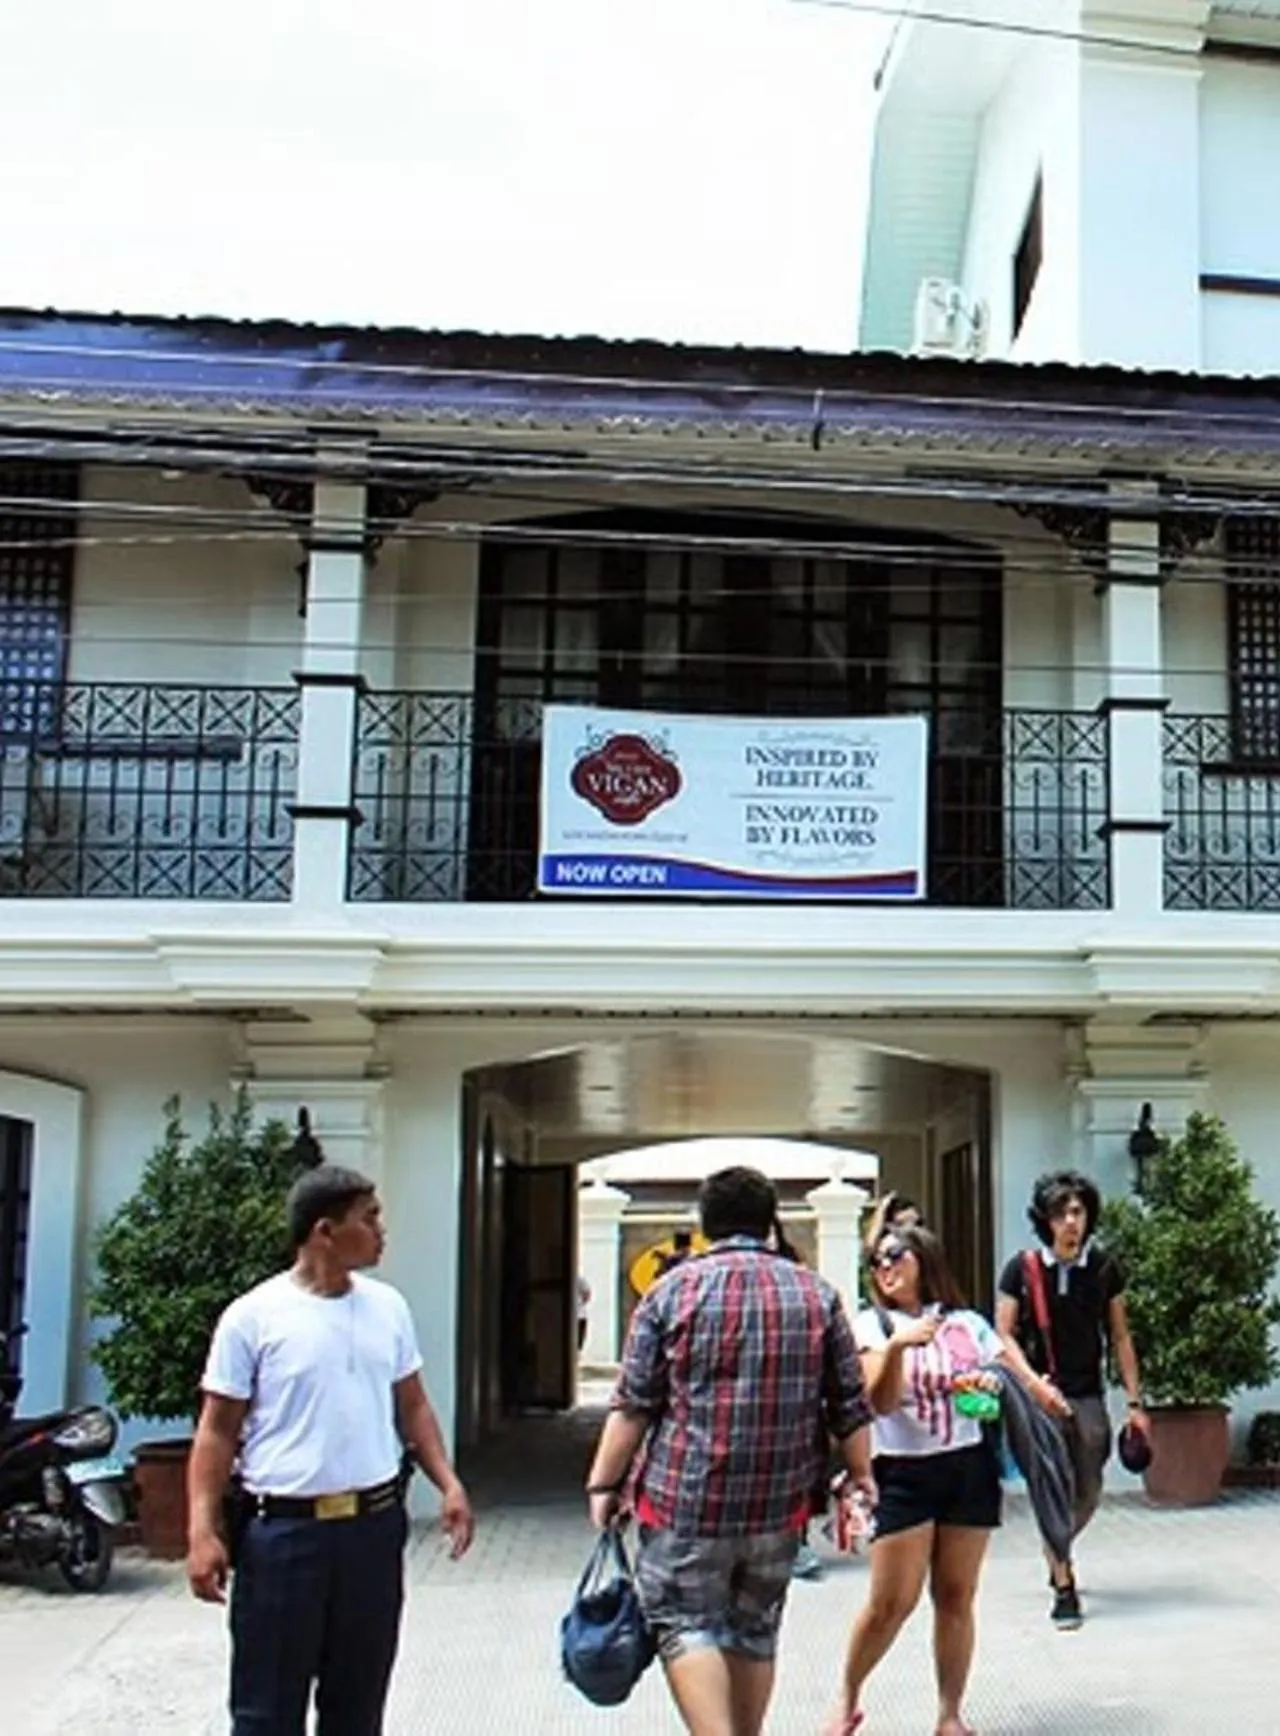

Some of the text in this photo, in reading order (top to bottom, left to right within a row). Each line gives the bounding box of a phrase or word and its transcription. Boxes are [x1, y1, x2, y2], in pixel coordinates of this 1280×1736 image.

[745, 746, 879, 768] INSPIRED BY
[587, 773, 668, 796] VIGAN
[745, 805, 879, 824] INNOVATED
[746, 826, 877, 847] BY FLAVORS
[556, 862, 668, 884] NOW OPEN
